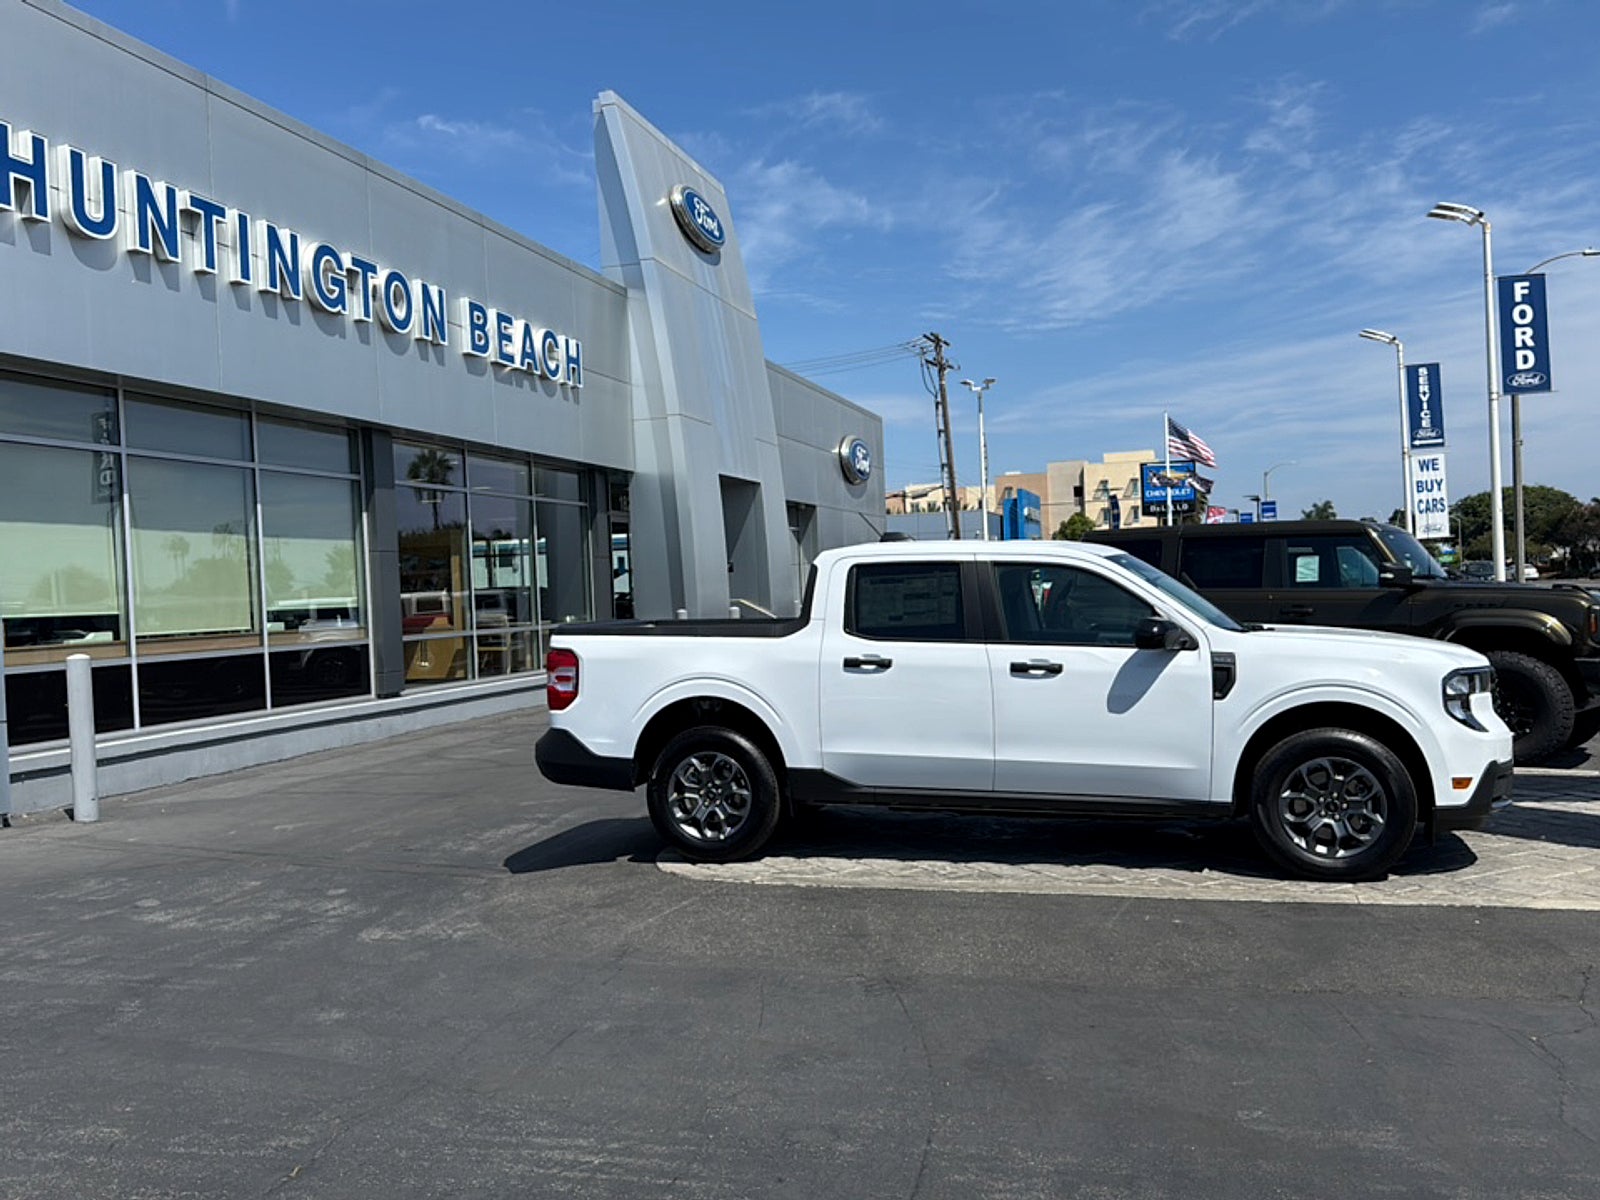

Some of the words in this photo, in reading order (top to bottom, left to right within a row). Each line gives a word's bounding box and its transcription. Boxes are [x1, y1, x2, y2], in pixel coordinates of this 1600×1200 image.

[693, 196, 720, 238] Ford
[0, 120, 449, 345] HUNTINGTON
[460, 297, 583, 388] BEACH
[1512, 281, 1535, 370] FORD
[1511, 372, 1540, 387] Ford
[1418, 366, 1431, 428] SERVICE
[855, 445, 870, 473] Ford
[1418, 458, 1440, 472] WE
[1145, 488, 1191, 498] CHEVOLET
[1416, 479, 1443, 493] BUY
[1417, 497, 1446, 514] CARS
